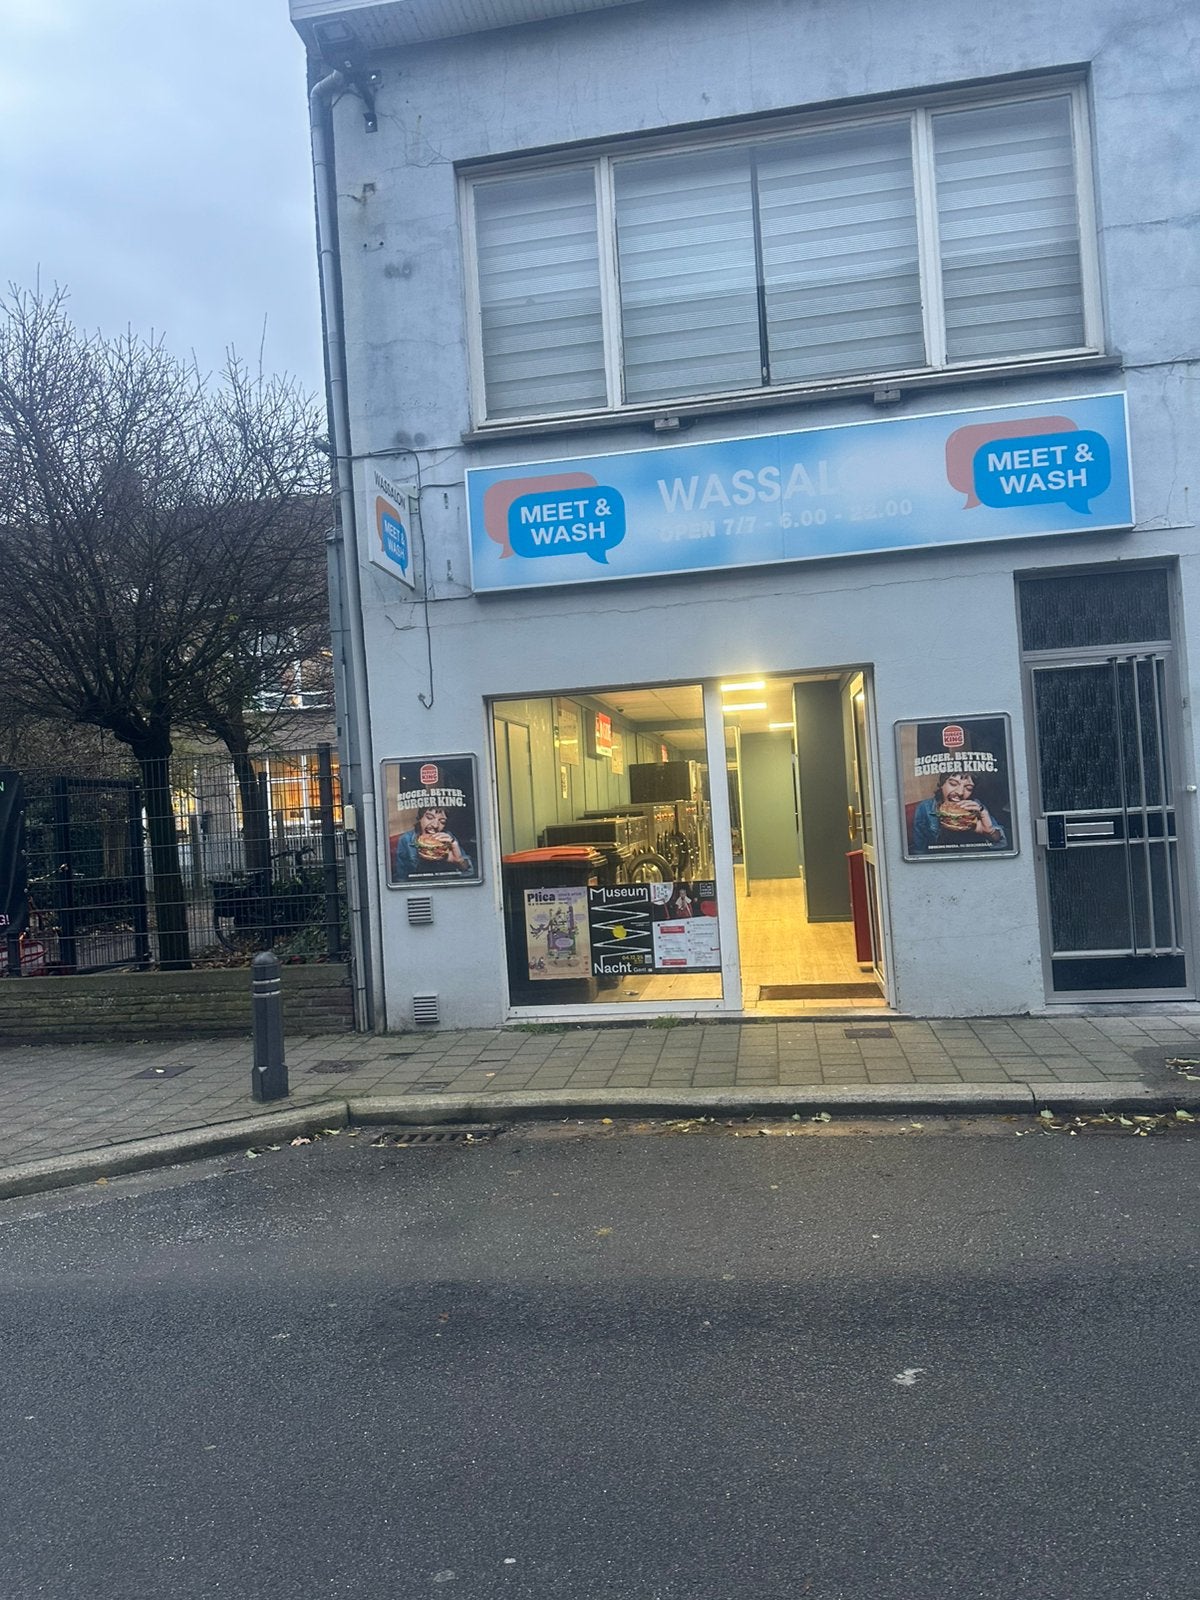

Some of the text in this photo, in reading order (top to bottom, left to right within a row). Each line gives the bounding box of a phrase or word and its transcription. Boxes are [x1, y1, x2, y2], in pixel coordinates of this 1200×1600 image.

[988, 443, 1095, 472] MEET &
[374, 471, 405, 510] WASSALON
[999, 468, 1088, 494] WASH
[520, 498, 613, 525] MEET &
[384, 520, 400, 539] MEET
[530, 521, 606, 546] WASH
[657, 519, 716, 543] OPEN
[723, 514, 758, 537] 7/7
[780, 509, 829, 530] 6.00
[388, 536, 405, 559] WASH
[914, 751, 998, 766] BIGGER. BETTER.
[914, 760, 999, 777] BURGER KING.
[397, 787, 466, 802] BIGGER. BETTER.
[397, 796, 467, 811] BURGER KING.
[527, 891, 556, 903] Plica
[589, 887, 649, 903] Museum
[594, 961, 632, 974] Nacht
